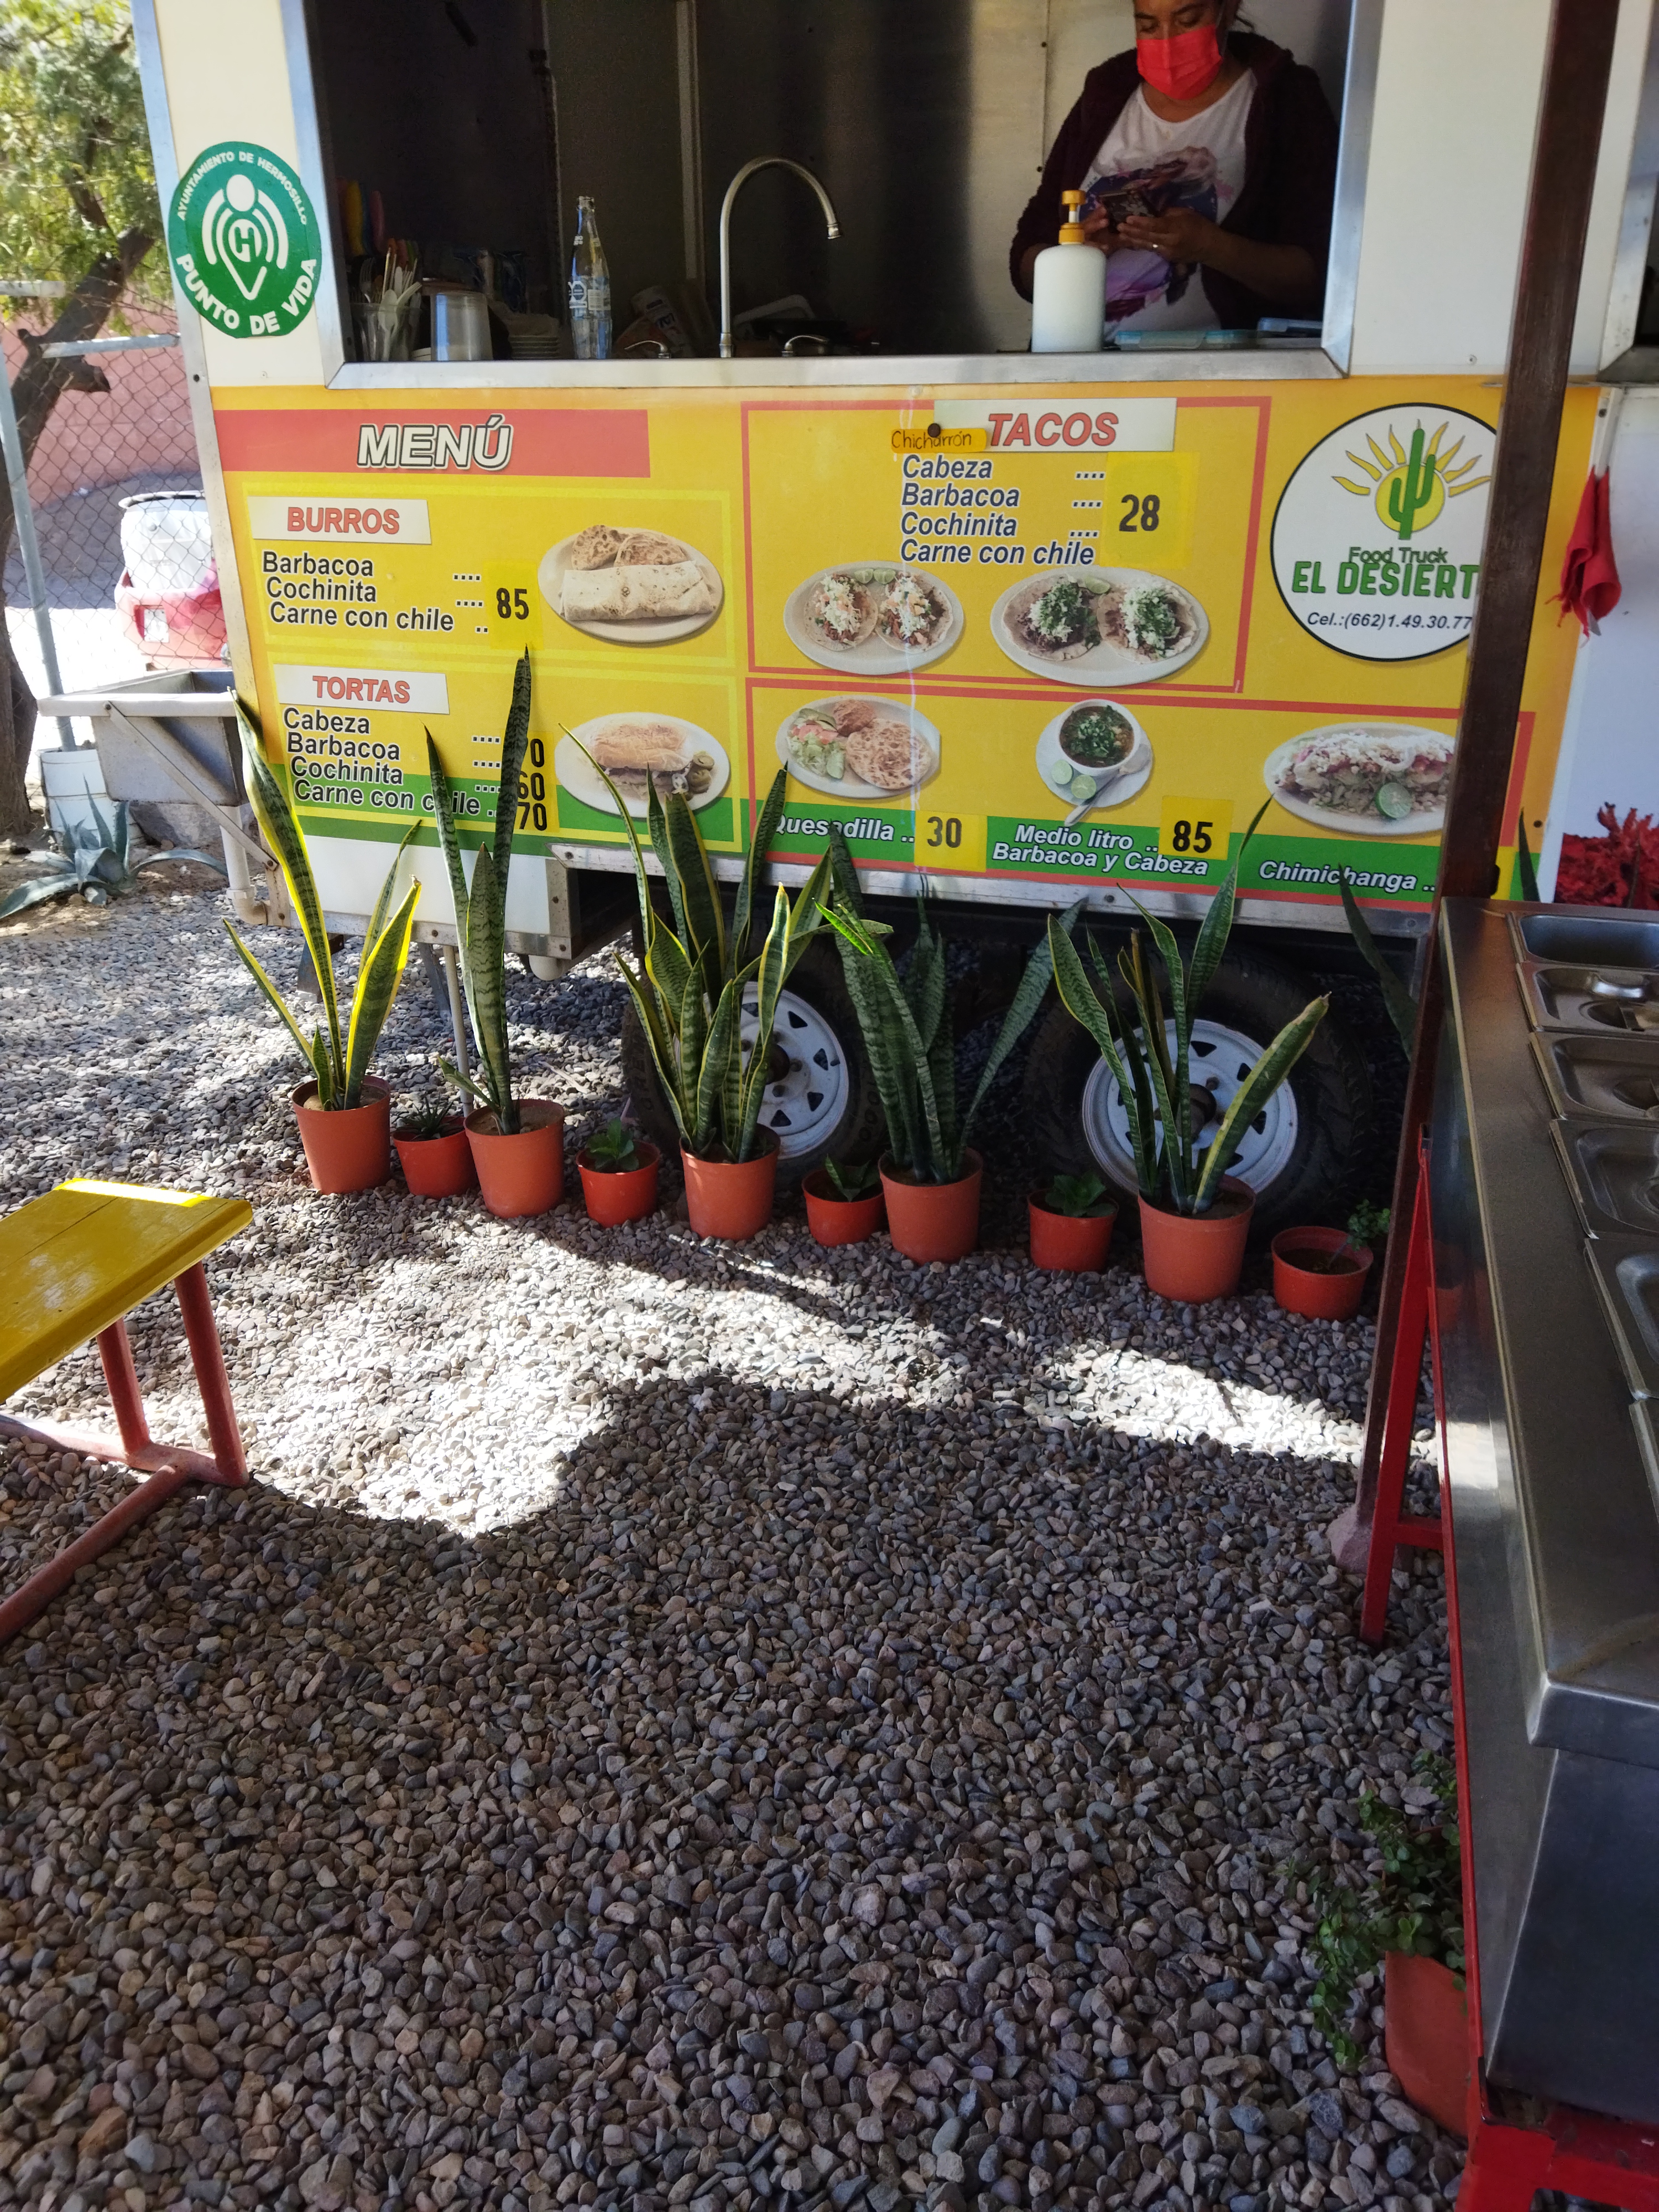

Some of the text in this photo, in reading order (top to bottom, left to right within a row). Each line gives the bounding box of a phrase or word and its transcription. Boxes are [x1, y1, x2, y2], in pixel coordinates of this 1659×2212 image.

[177, 151, 307, 225] AYUNTAMIENTO DE HERMOSILLO
[176, 253, 317, 335] PUNTO DE VIDA
[357, 413, 514, 471] MENÚ
[891, 430, 972, 450] Chicharrón
[988, 412, 1119, 447] TACOS
[902, 454, 993, 479] Cabeza
[901, 483, 1020, 508] Barbacoa
[287, 507, 400, 535] BURROS
[901, 511, 1016, 537] Cochinita
[1118, 494, 1161, 533] 28
[262, 551, 374, 577] Barbacoa
[900, 538, 1094, 566] Carne con chile
[1349, 546, 1448, 563] Food Truck
[266, 576, 377, 603] Cochinita
[1292, 561, 1480, 599] EL DESIERT
[269, 602, 455, 634] Carne con chile
[496, 587, 529, 620] 85
[312, 675, 410, 703] TORTAS
[283, 706, 371, 735] Cabeza
[287, 731, 400, 761] Barbacoa
[290, 755, 403, 786] Cochinita
[294, 779, 481, 816] Carne con cile
[518, 771, 545, 801] 60
[518, 802, 547, 831] 70
[927, 816, 962, 848] 30
[1015, 825, 1133, 851] Medio litro
[1172, 820, 1213, 854] 85
[992, 842, 1208, 876] Barbacoa y Cabeza
[1259, 860, 1417, 894] Chimichanga
